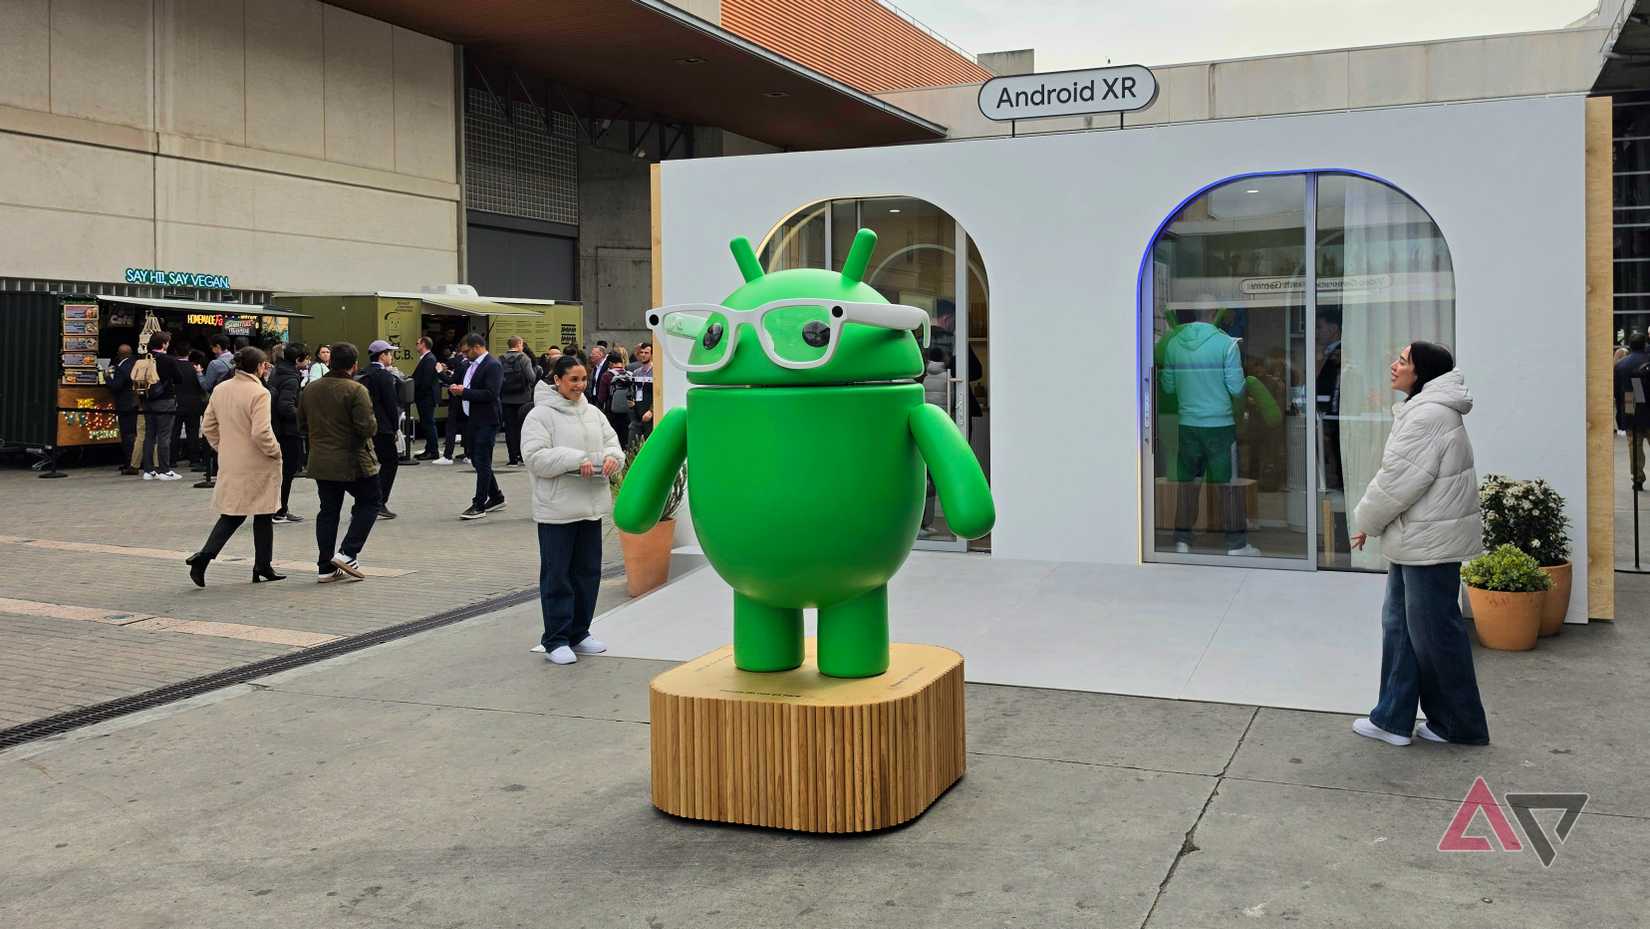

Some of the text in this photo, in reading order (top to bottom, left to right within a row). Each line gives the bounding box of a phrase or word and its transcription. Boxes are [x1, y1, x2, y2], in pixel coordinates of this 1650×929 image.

[996, 76, 1137, 109] Android XR
[127, 269, 148, 282] SAY
[169, 272, 189, 285] SAY
